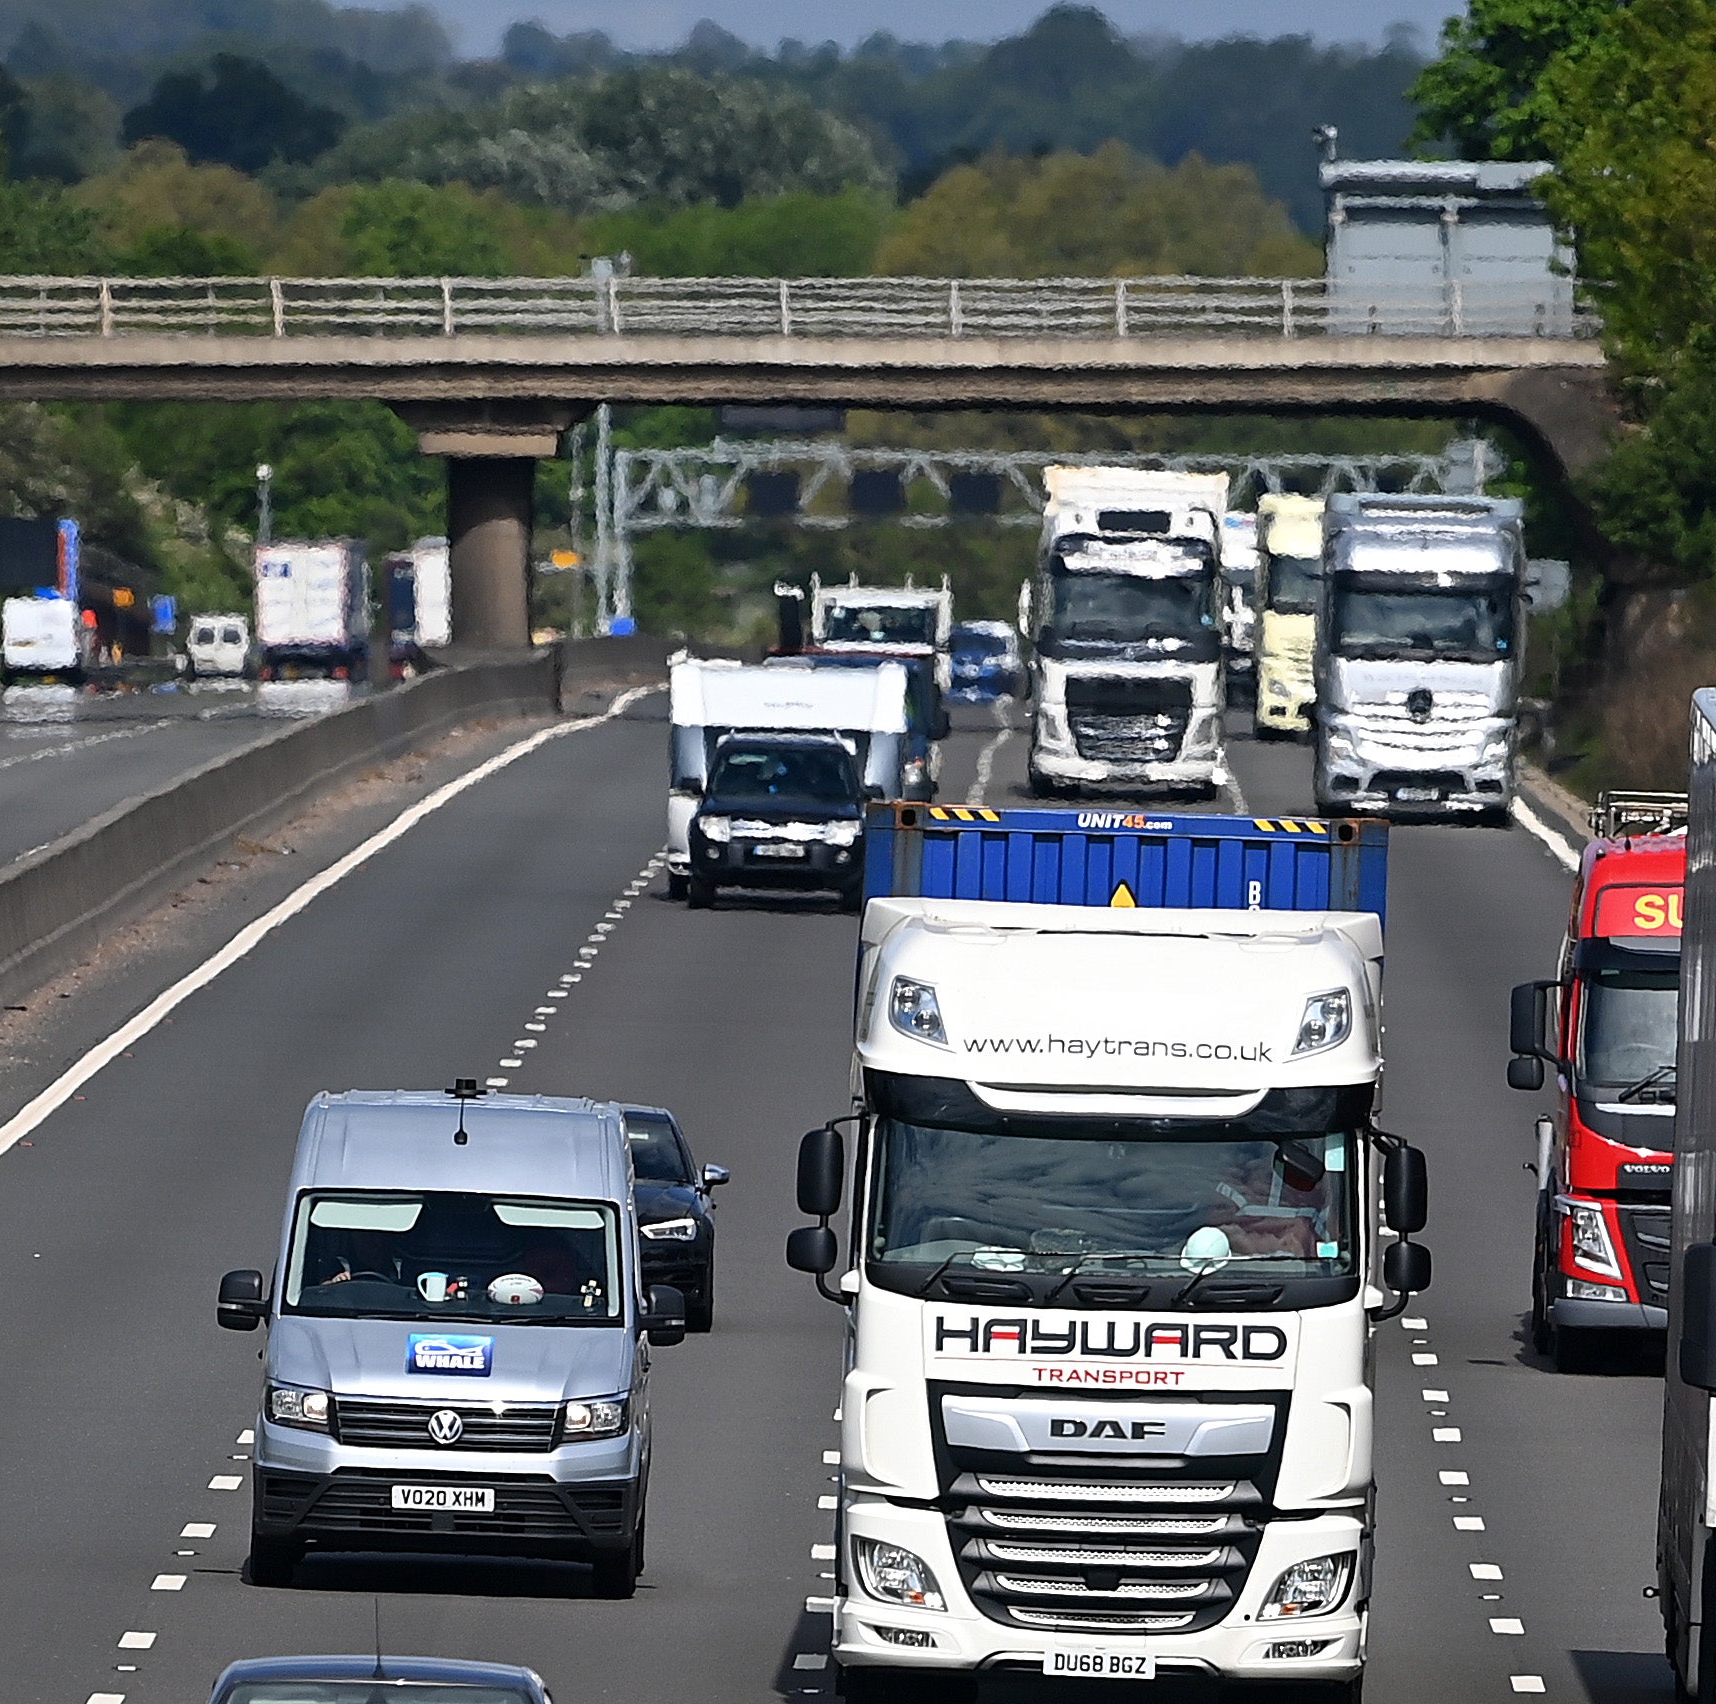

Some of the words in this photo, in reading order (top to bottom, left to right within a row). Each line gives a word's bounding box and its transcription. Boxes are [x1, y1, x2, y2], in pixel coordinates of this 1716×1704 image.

[1077, 813, 1173, 830] UNIT45.com
[963, 1033, 1273, 1063] www.haytrans.co.uk
[1624, 1164, 1671, 1174] VOLVO
[935, 1315, 1288, 1361] HAYWARD
[415, 1354, 485, 1369] WHALE
[1032, 1367, 1185, 1385] TRANSPORT
[1049, 1418, 1166, 1440] DAF
[401, 1488, 447, 1507] VO20
[452, 1490, 486, 1508] XHM
[1054, 1653, 1104, 1673] DU68
[1109, 1656, 1147, 1674] BGZ
